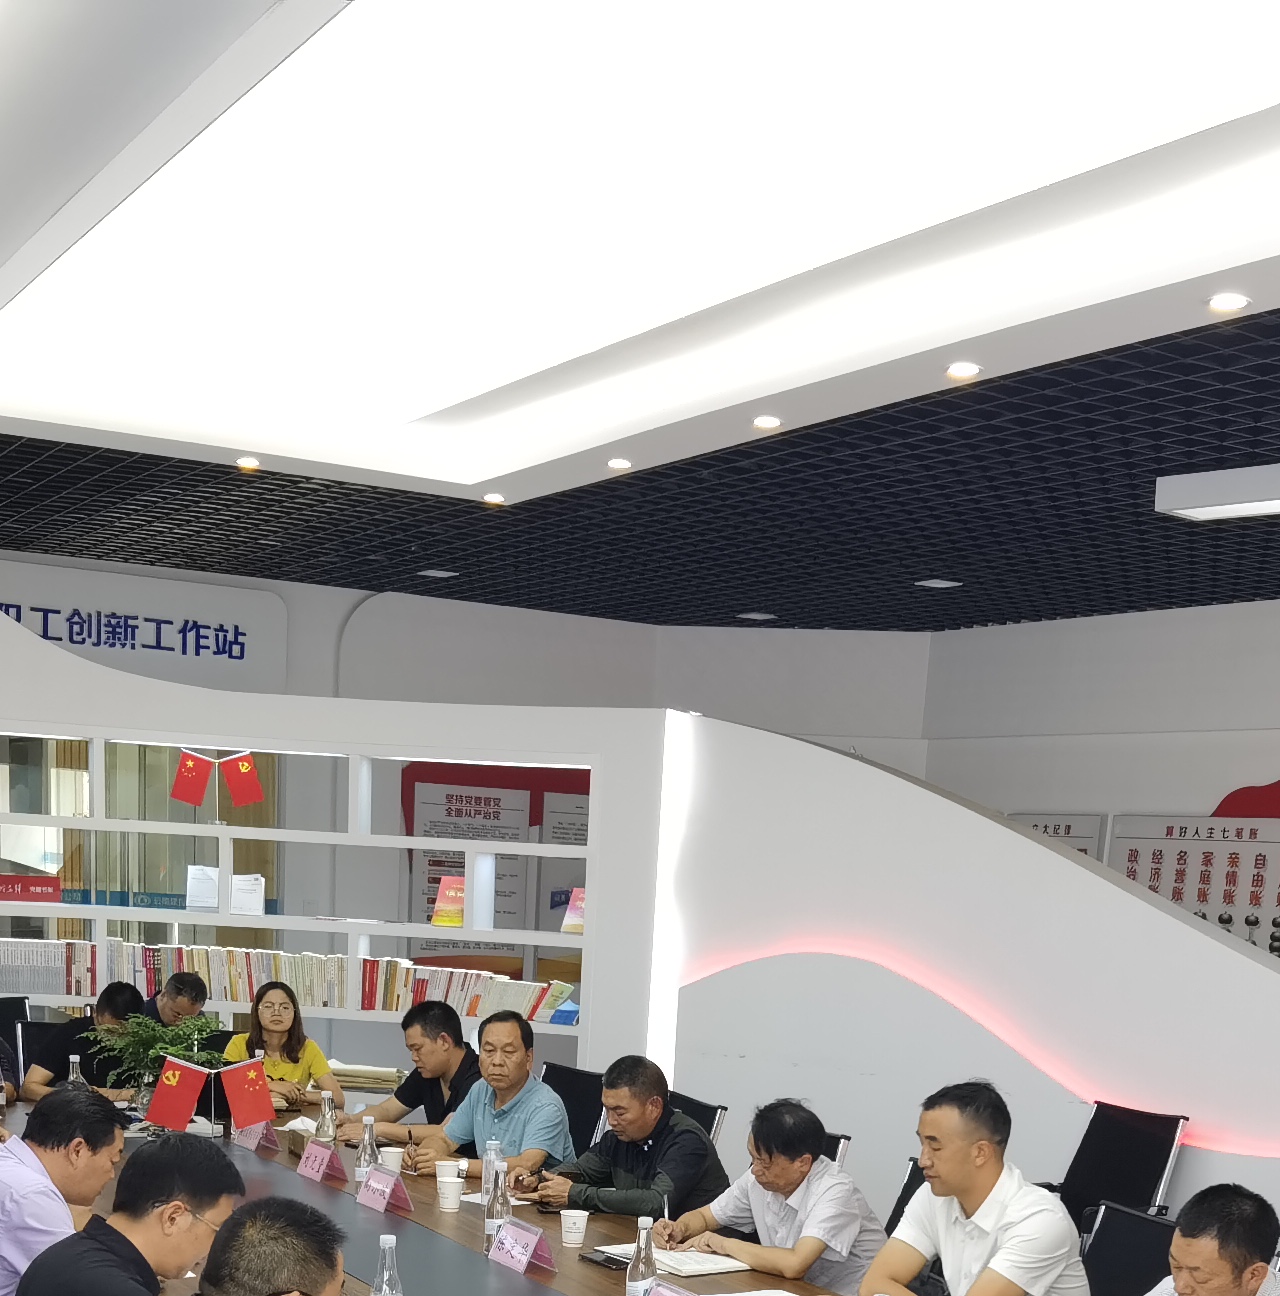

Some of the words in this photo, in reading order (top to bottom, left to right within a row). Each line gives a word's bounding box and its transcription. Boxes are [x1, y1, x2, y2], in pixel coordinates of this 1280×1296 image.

[445, 793, 502, 808] 坚持党要管党
[445, 807, 502, 821] 全面从严治党
[1196, 851, 1214, 904] 家庭账
[1222, 852, 1240, 906] 亲情账
[1248, 853, 1266, 907] 自由账
